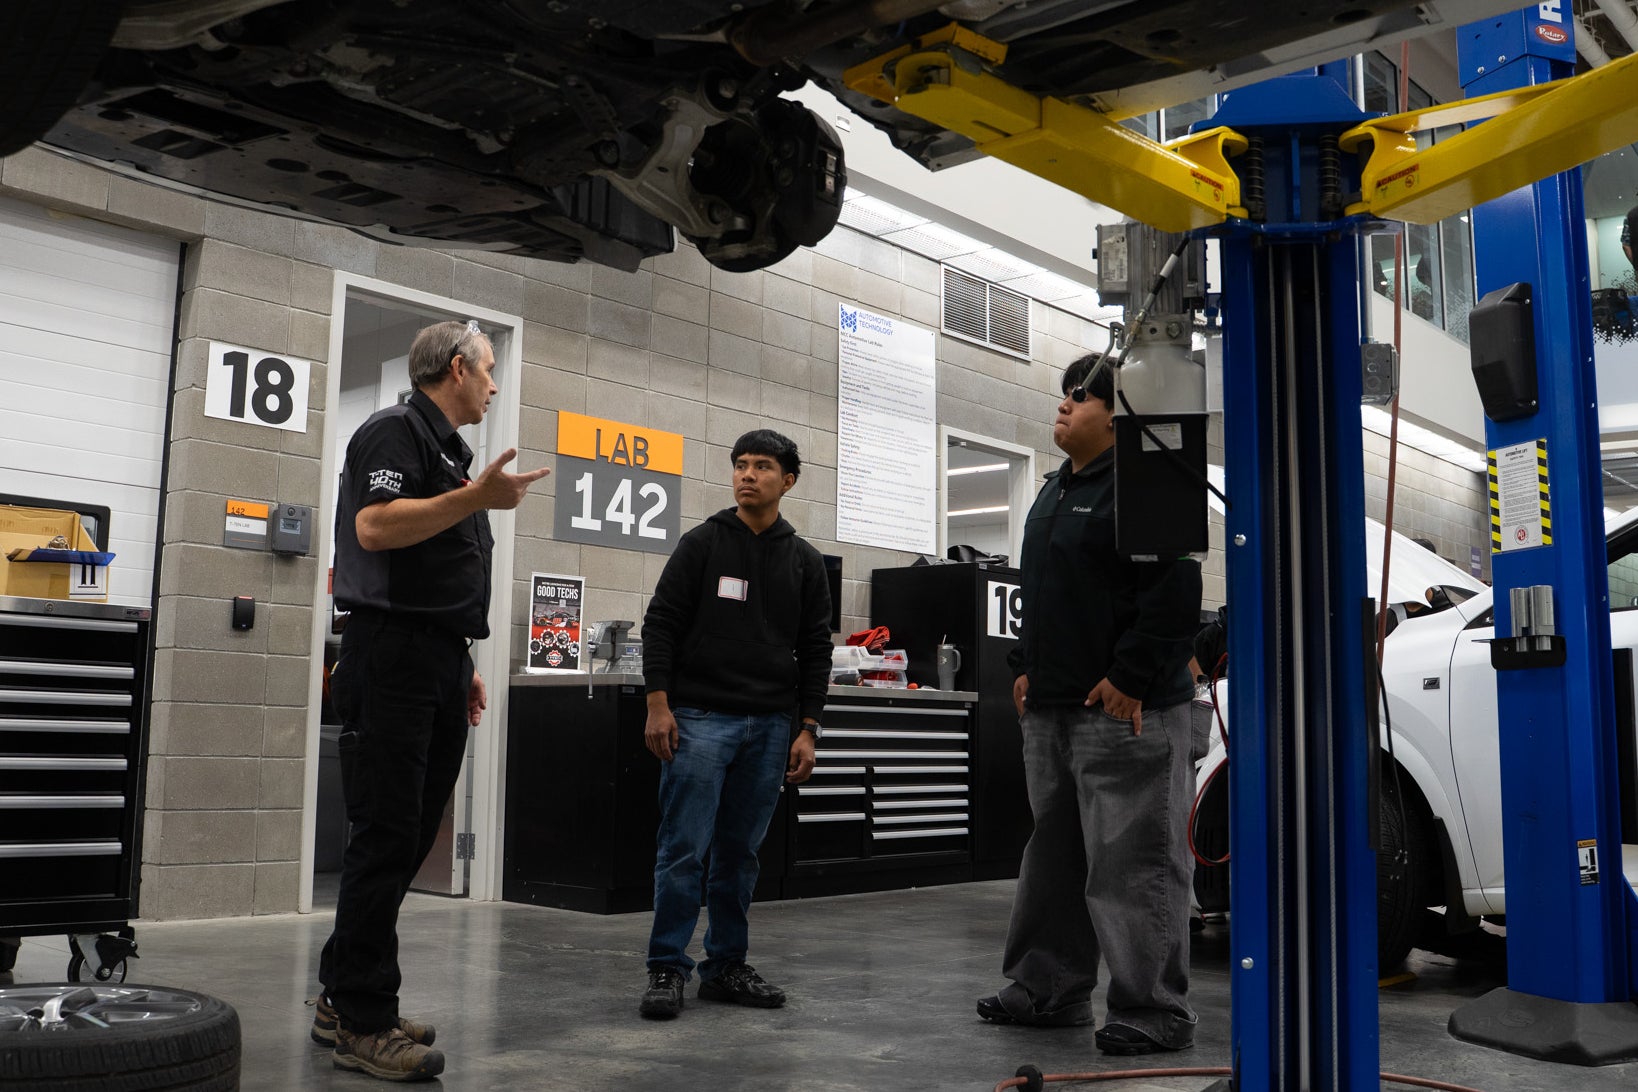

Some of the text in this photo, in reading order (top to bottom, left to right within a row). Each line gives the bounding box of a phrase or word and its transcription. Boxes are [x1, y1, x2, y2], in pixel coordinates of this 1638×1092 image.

[1537, 26, 1565, 41] Rotary
[859, 312, 892, 327] AUTOMOTIVE
[860, 320, 893, 336] TECHNOLOGY
[223, 351, 295, 424] 18
[595, 428, 650, 469] LAB
[370, 476, 401, 489] 40TH
[231, 506, 246, 516] 142
[571, 472, 668, 540] 142
[537, 585, 578, 600] GOOD TECHS
[995, 586, 1022, 638] 19
